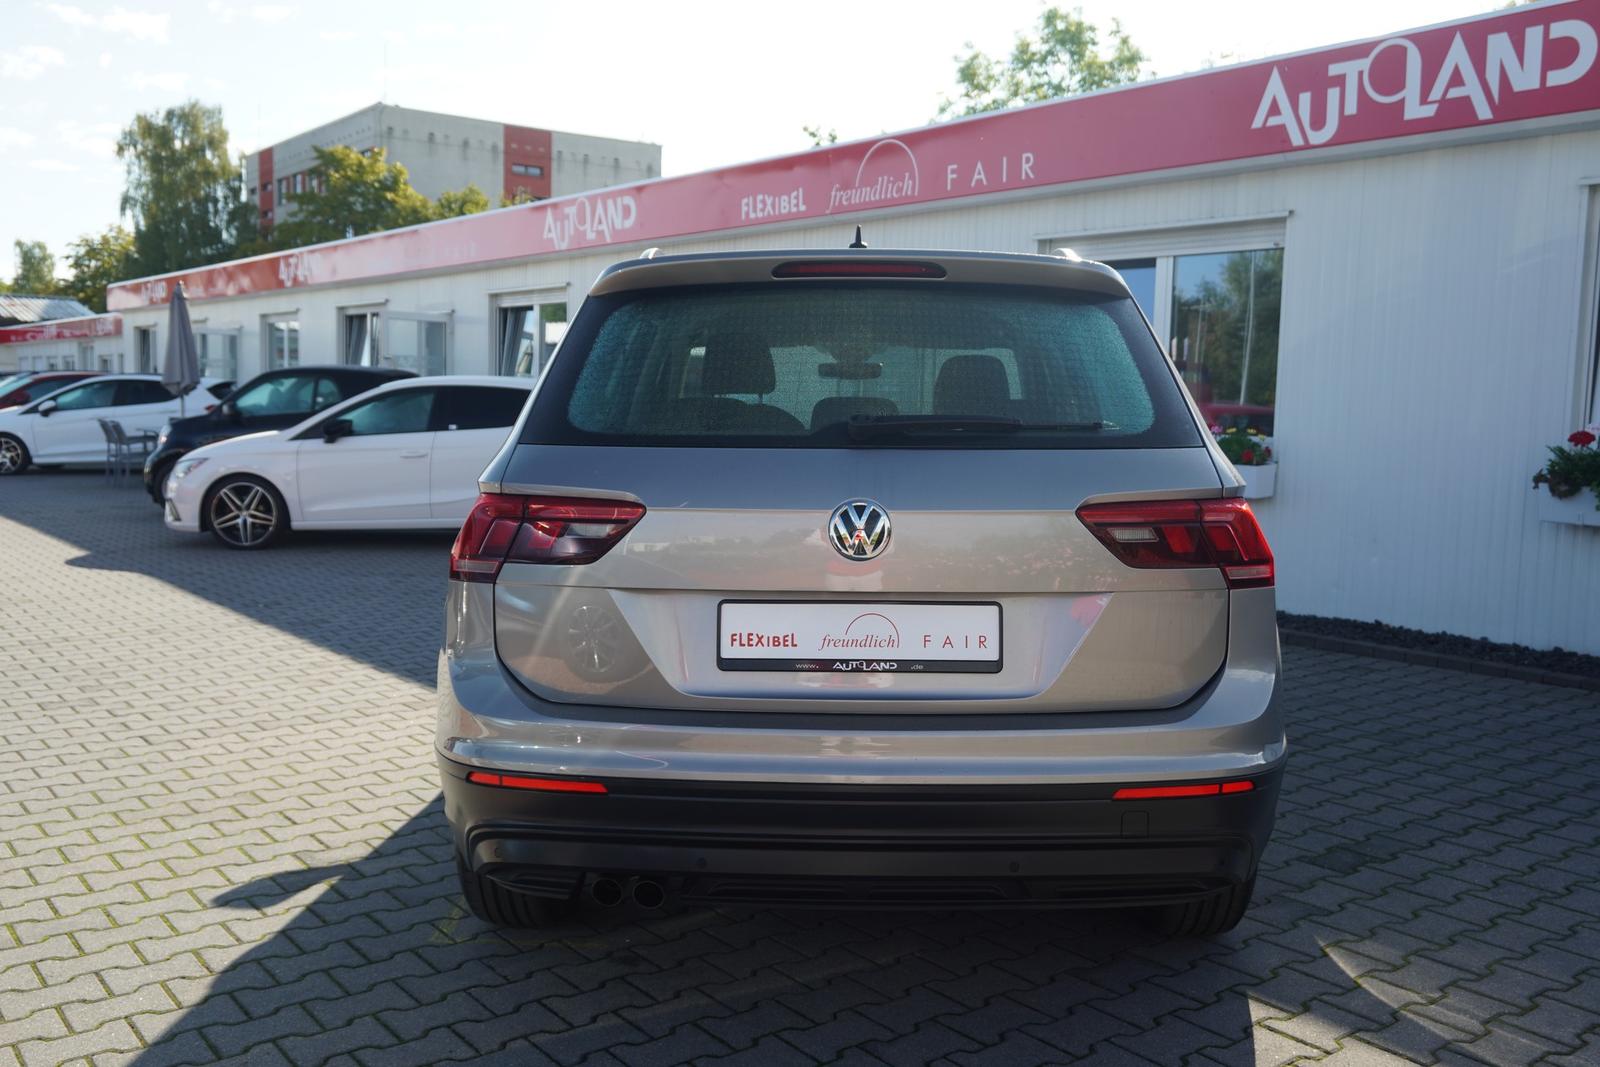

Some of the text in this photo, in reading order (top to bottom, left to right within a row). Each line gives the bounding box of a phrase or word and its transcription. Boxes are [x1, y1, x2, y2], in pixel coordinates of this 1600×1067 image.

[1251, 19, 1599, 147] AUTOLAND
[741, 152, 1035, 220] FLEXIBEL freundlich FAIR
[543, 195, 637, 250] AUTOLAND
[730, 632, 988, 651] FLEXIBEL freundlich FAIR
[833, 660, 898, 671] AUTOLAND
